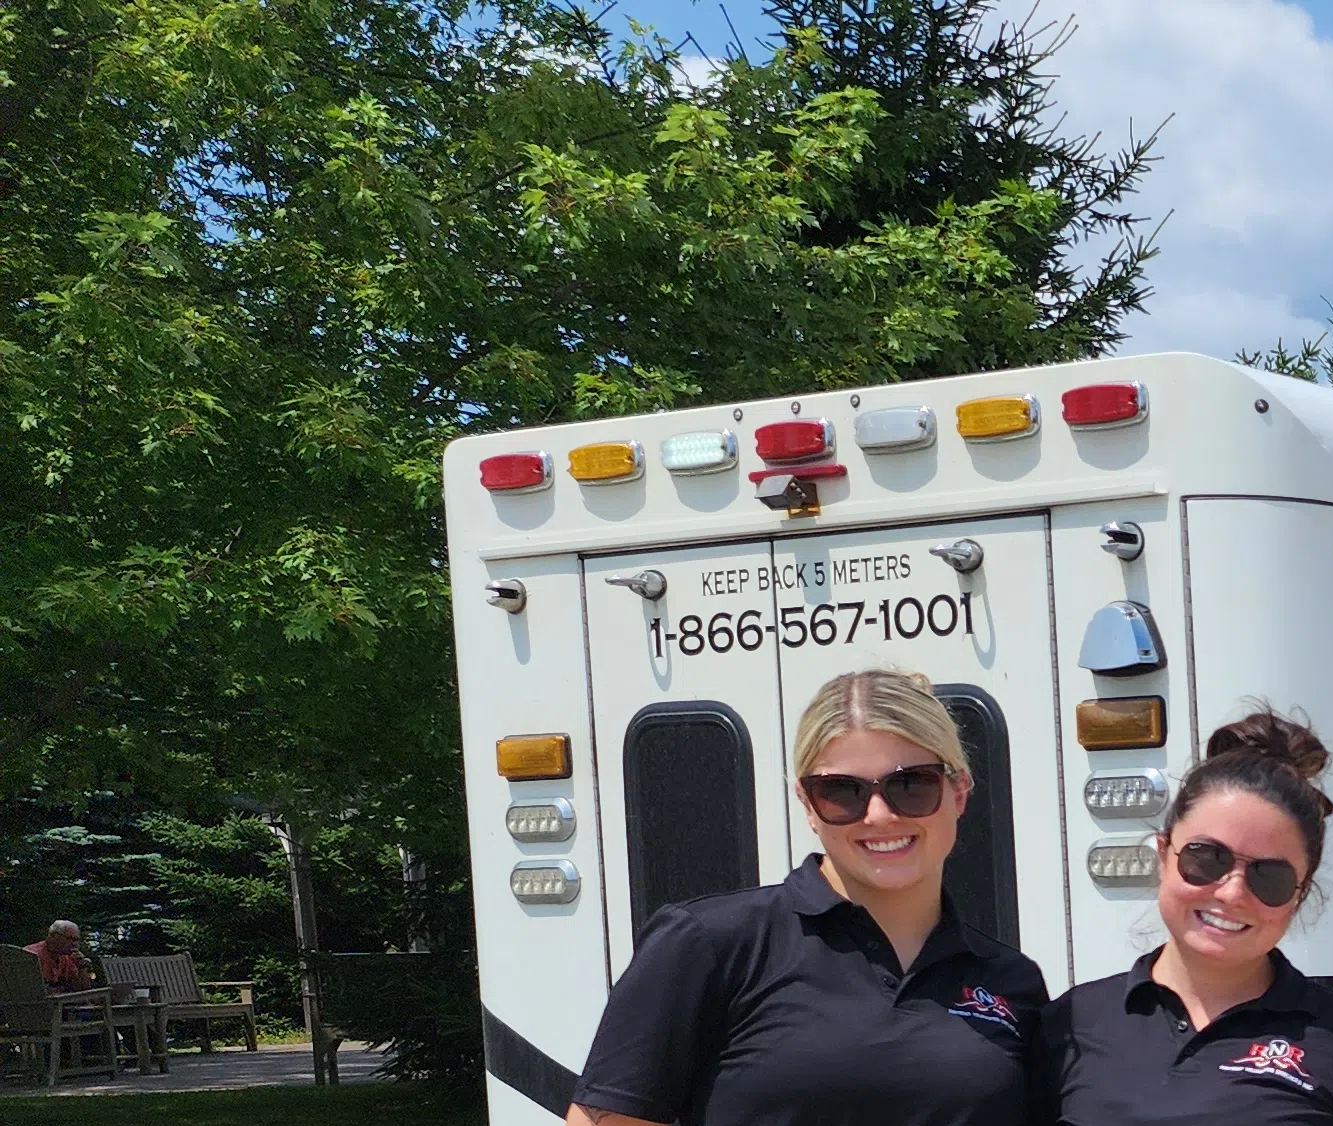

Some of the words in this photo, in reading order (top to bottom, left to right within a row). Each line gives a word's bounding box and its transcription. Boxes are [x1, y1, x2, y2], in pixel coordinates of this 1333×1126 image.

[701, 568, 750, 597] KEEP
[758, 562, 808, 591] BACK
[814, 561, 826, 587] 5
[833, 554, 911, 585] METERS
[650, 591, 975, 659] 1-866-567-1001
[1248, 1041, 1305, 1063] RNR
